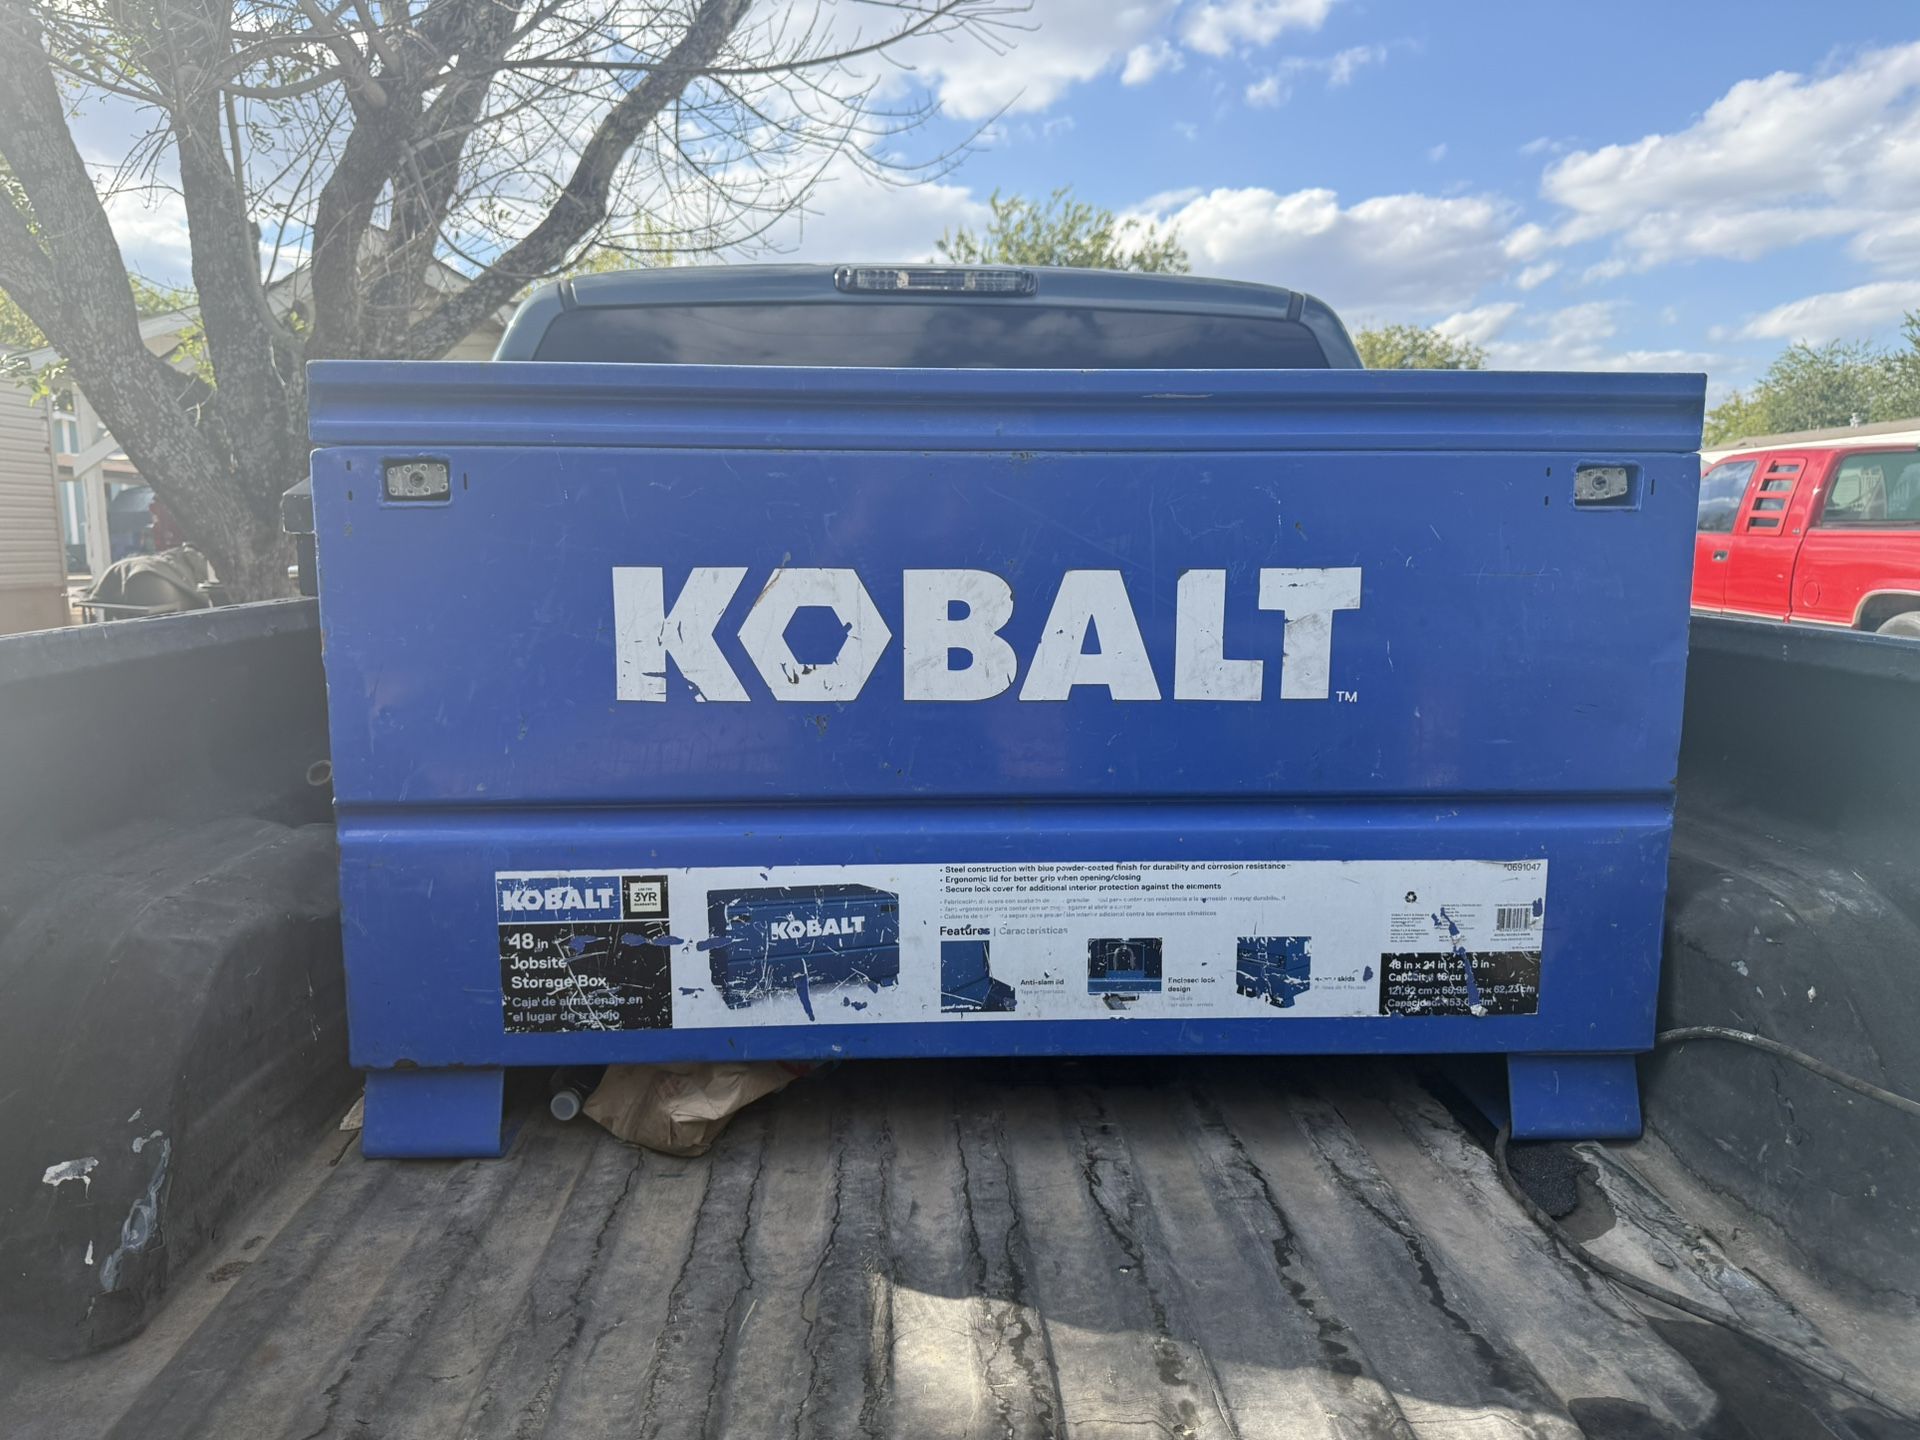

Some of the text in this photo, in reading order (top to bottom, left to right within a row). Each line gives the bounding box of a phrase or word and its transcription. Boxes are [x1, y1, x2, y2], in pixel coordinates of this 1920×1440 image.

[612, 565, 1362, 702] KOBALT
[1336, 691, 1358, 702] TM
[945, 865, 965, 874] Steel
[967, 864, 1017, 873] construction
[1018, 864, 1036, 872] with
[1038, 864, 1054, 872] blue
[1056, 864, 1114, 874] powder-coated
[1152, 863, 1189, 872] durability
[945, 876, 987, 884] Ergonomic
[1013, 874, 1038, 882] better
[1040, 874, 1055, 884] grip
[1057, 874, 1078, 882] when
[1080, 873, 1141, 882] opening/closing
[945, 885, 972, 893] Secure
[974, 884, 991, 892] lock
[1016, 884, 1027, 892] for
[1029, 884, 1067, 892] additional
[1069, 884, 1096, 892] interior
[1099, 883, 1140, 892] protection
[1141, 882, 1169, 892] against
[1172, 882, 1184, 890] the
[1186, 882, 1222, 890] elements
[502, 887, 614, 911] KOBALT
[633, 892, 658, 902] 3YR
[771, 915, 866, 941] KOBALT
[940, 925, 991, 936] Features
[508, 932, 549, 950] 48 in
[510, 956, 568, 971] Jobsite
[1388, 958, 1402, 970] 48
[1404, 960, 1413, 969] in
[1422, 960, 1435, 970] 24
[1438, 960, 1446, 969] in
[1456, 960, 1478, 969] 25
[1480, 960, 1490, 968] in
[511, 974, 607, 990] Storage Box
[1020, 978, 1054, 986] Anti-slam
[1450, 974, 1461, 982] cu
[1168, 986, 1191, 994] design
[1388, 986, 1416, 996] 121,92
[1494, 985, 1520, 994] 62,23
[512, 997, 538, 1008] Caja
[541, 996, 556, 1007] de
[559, 995, 625, 1008] almacenaje
[513, 1009, 620, 1024] el lugar de trabajo
